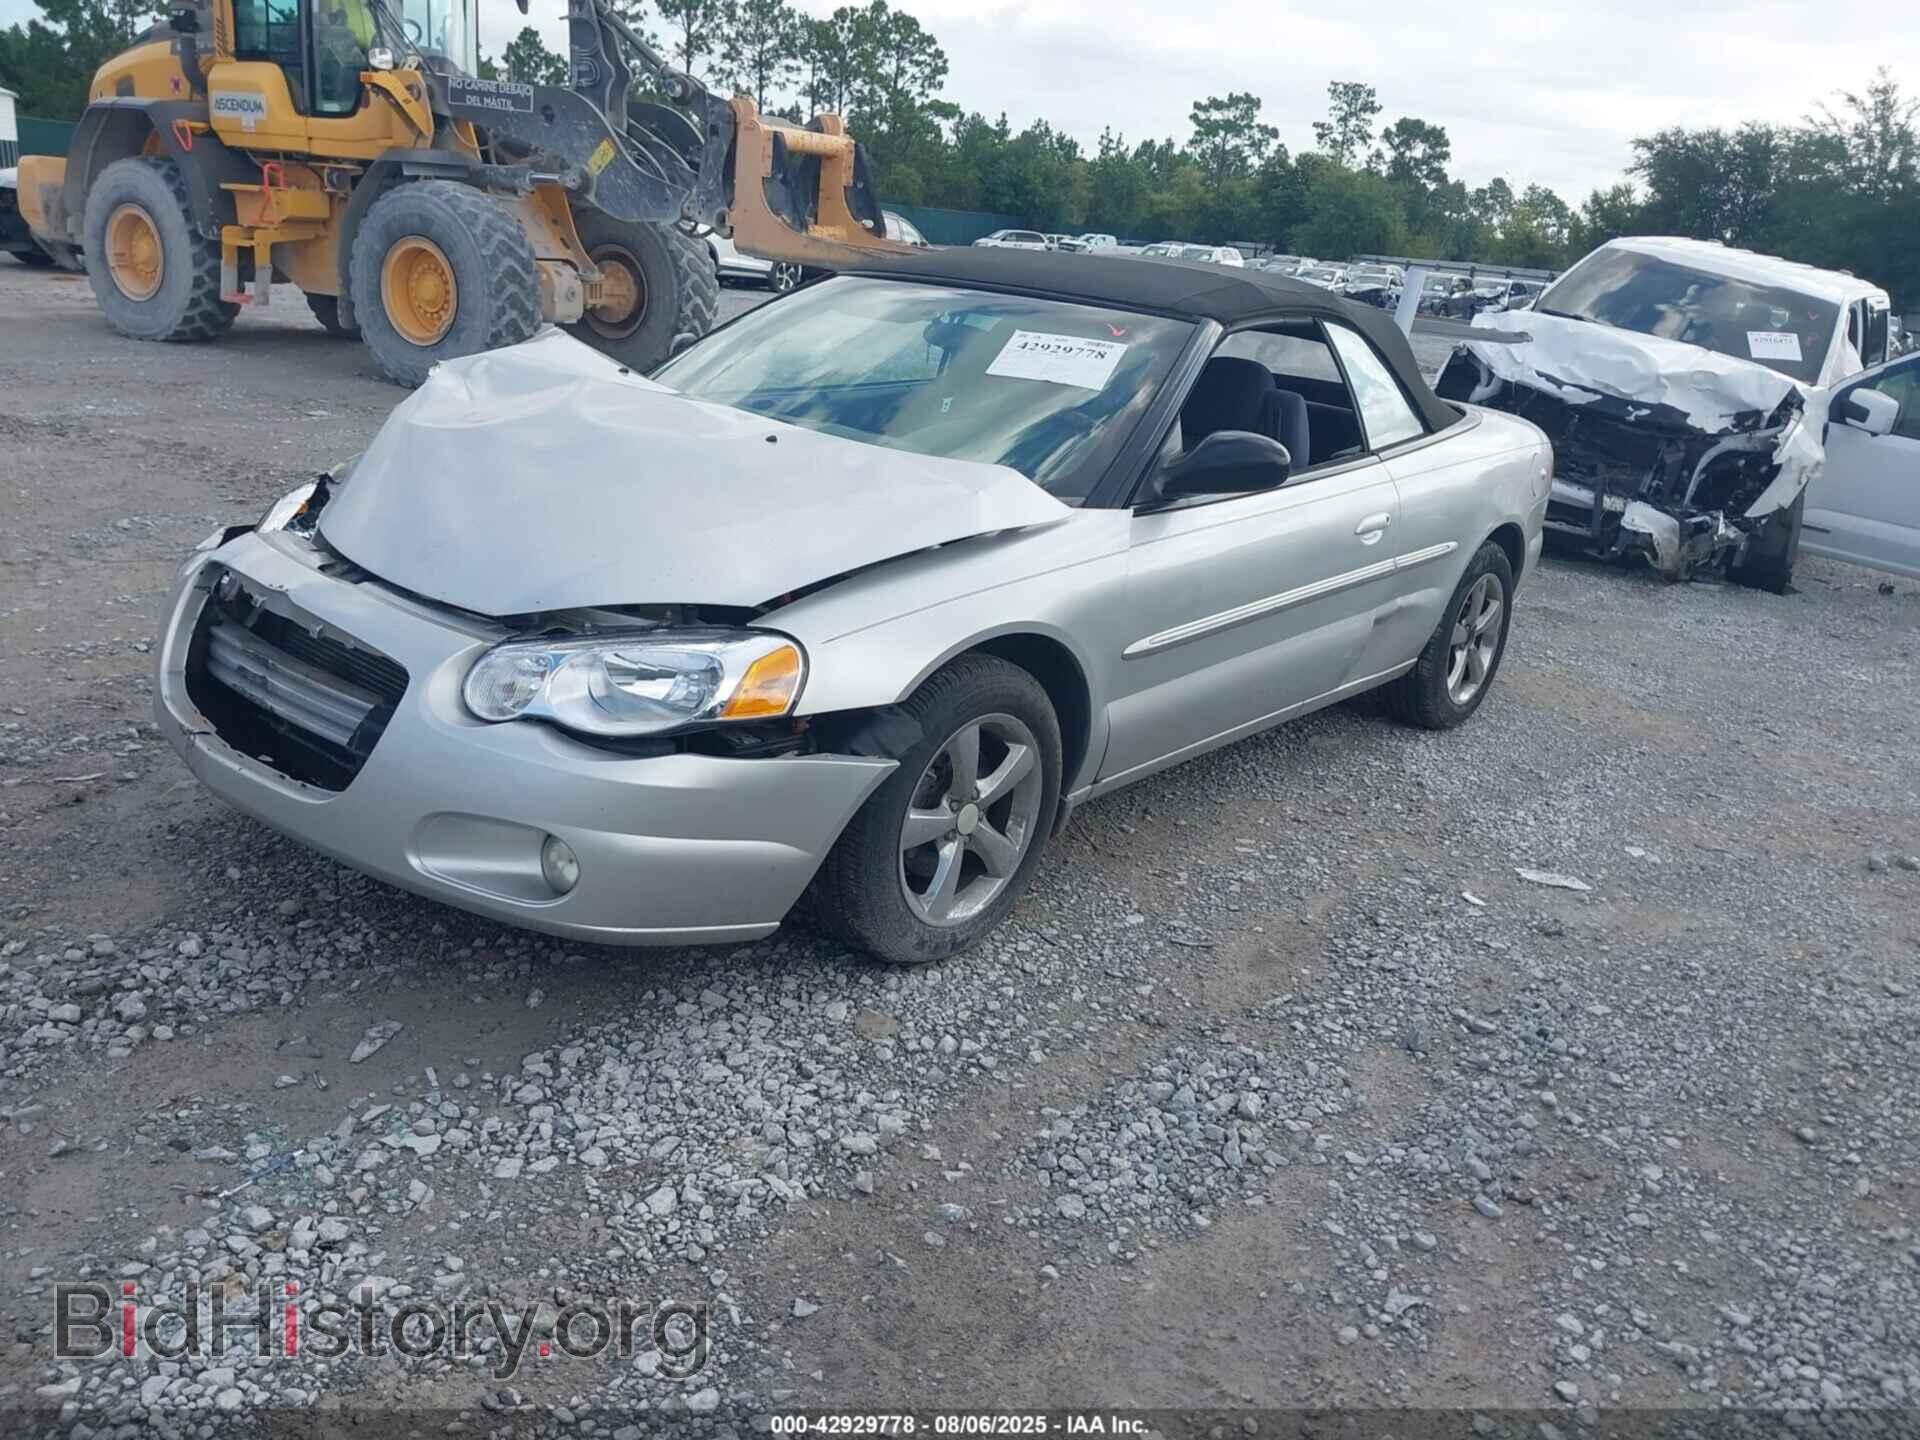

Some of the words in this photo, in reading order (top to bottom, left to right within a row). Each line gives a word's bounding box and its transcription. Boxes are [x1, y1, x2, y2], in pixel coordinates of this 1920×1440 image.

[449, 77, 463, 89] NO
[464, 80, 497, 93] CAMINE
[465, 94, 481, 106] DEL
[1017, 341, 1107, 359] 42929778
